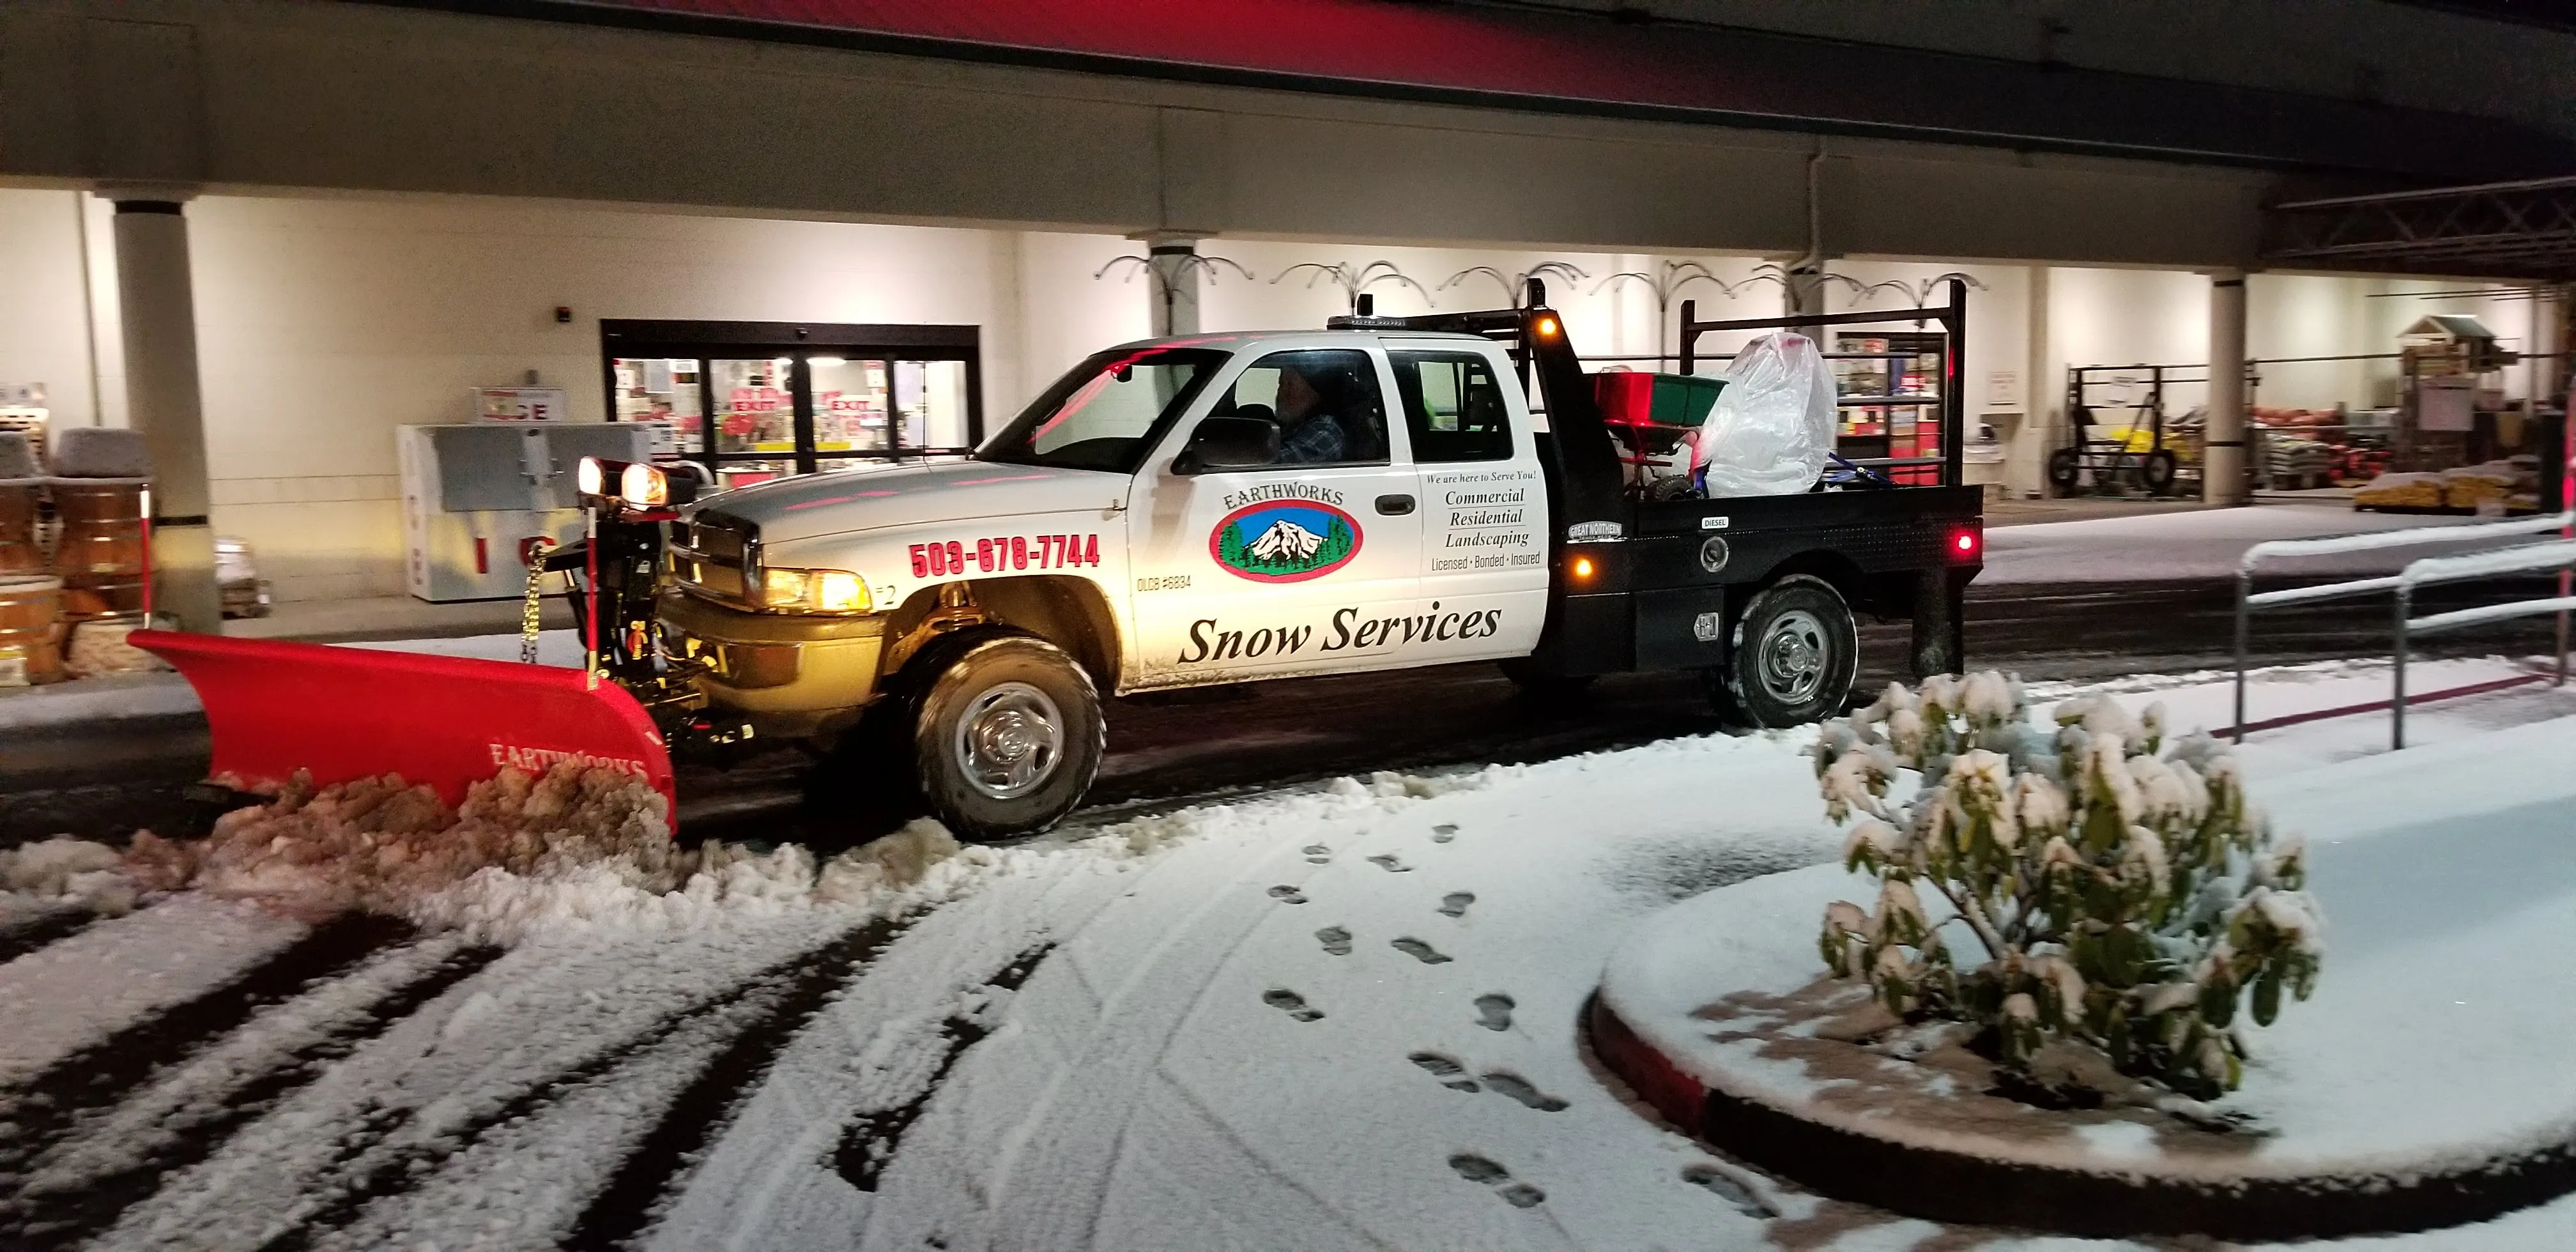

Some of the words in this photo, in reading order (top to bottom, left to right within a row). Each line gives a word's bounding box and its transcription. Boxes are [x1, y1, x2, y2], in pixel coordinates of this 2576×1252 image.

[831, 401, 869, 411] EXIT
[1427, 475, 1441, 484] We
[1460, 474, 1478, 483] here
[1491, 472, 1514, 480] Serve
[1517, 471, 1536, 480] You!
[1223, 482, 1344, 510] EARTHWORKS
[1445, 488, 1524, 505] Commercial
[1450, 509, 1523, 526] Residential
[1705, 519, 1726, 527] DIESEL
[1570, 524, 1589, 537] GREAT
[1589, 522, 1621, 535] NORTHERN
[1445, 530, 1529, 548] Landscaping
[908, 534, 1100, 577] 503-678-7744
[1432, 556, 1468, 570] Licensed
[1475, 554, 1505, 568] Bonded
[1511, 551, 1540, 566] Insured
[1177, 618, 1312, 665] Snow
[1319, 600, 1503, 652] Services
